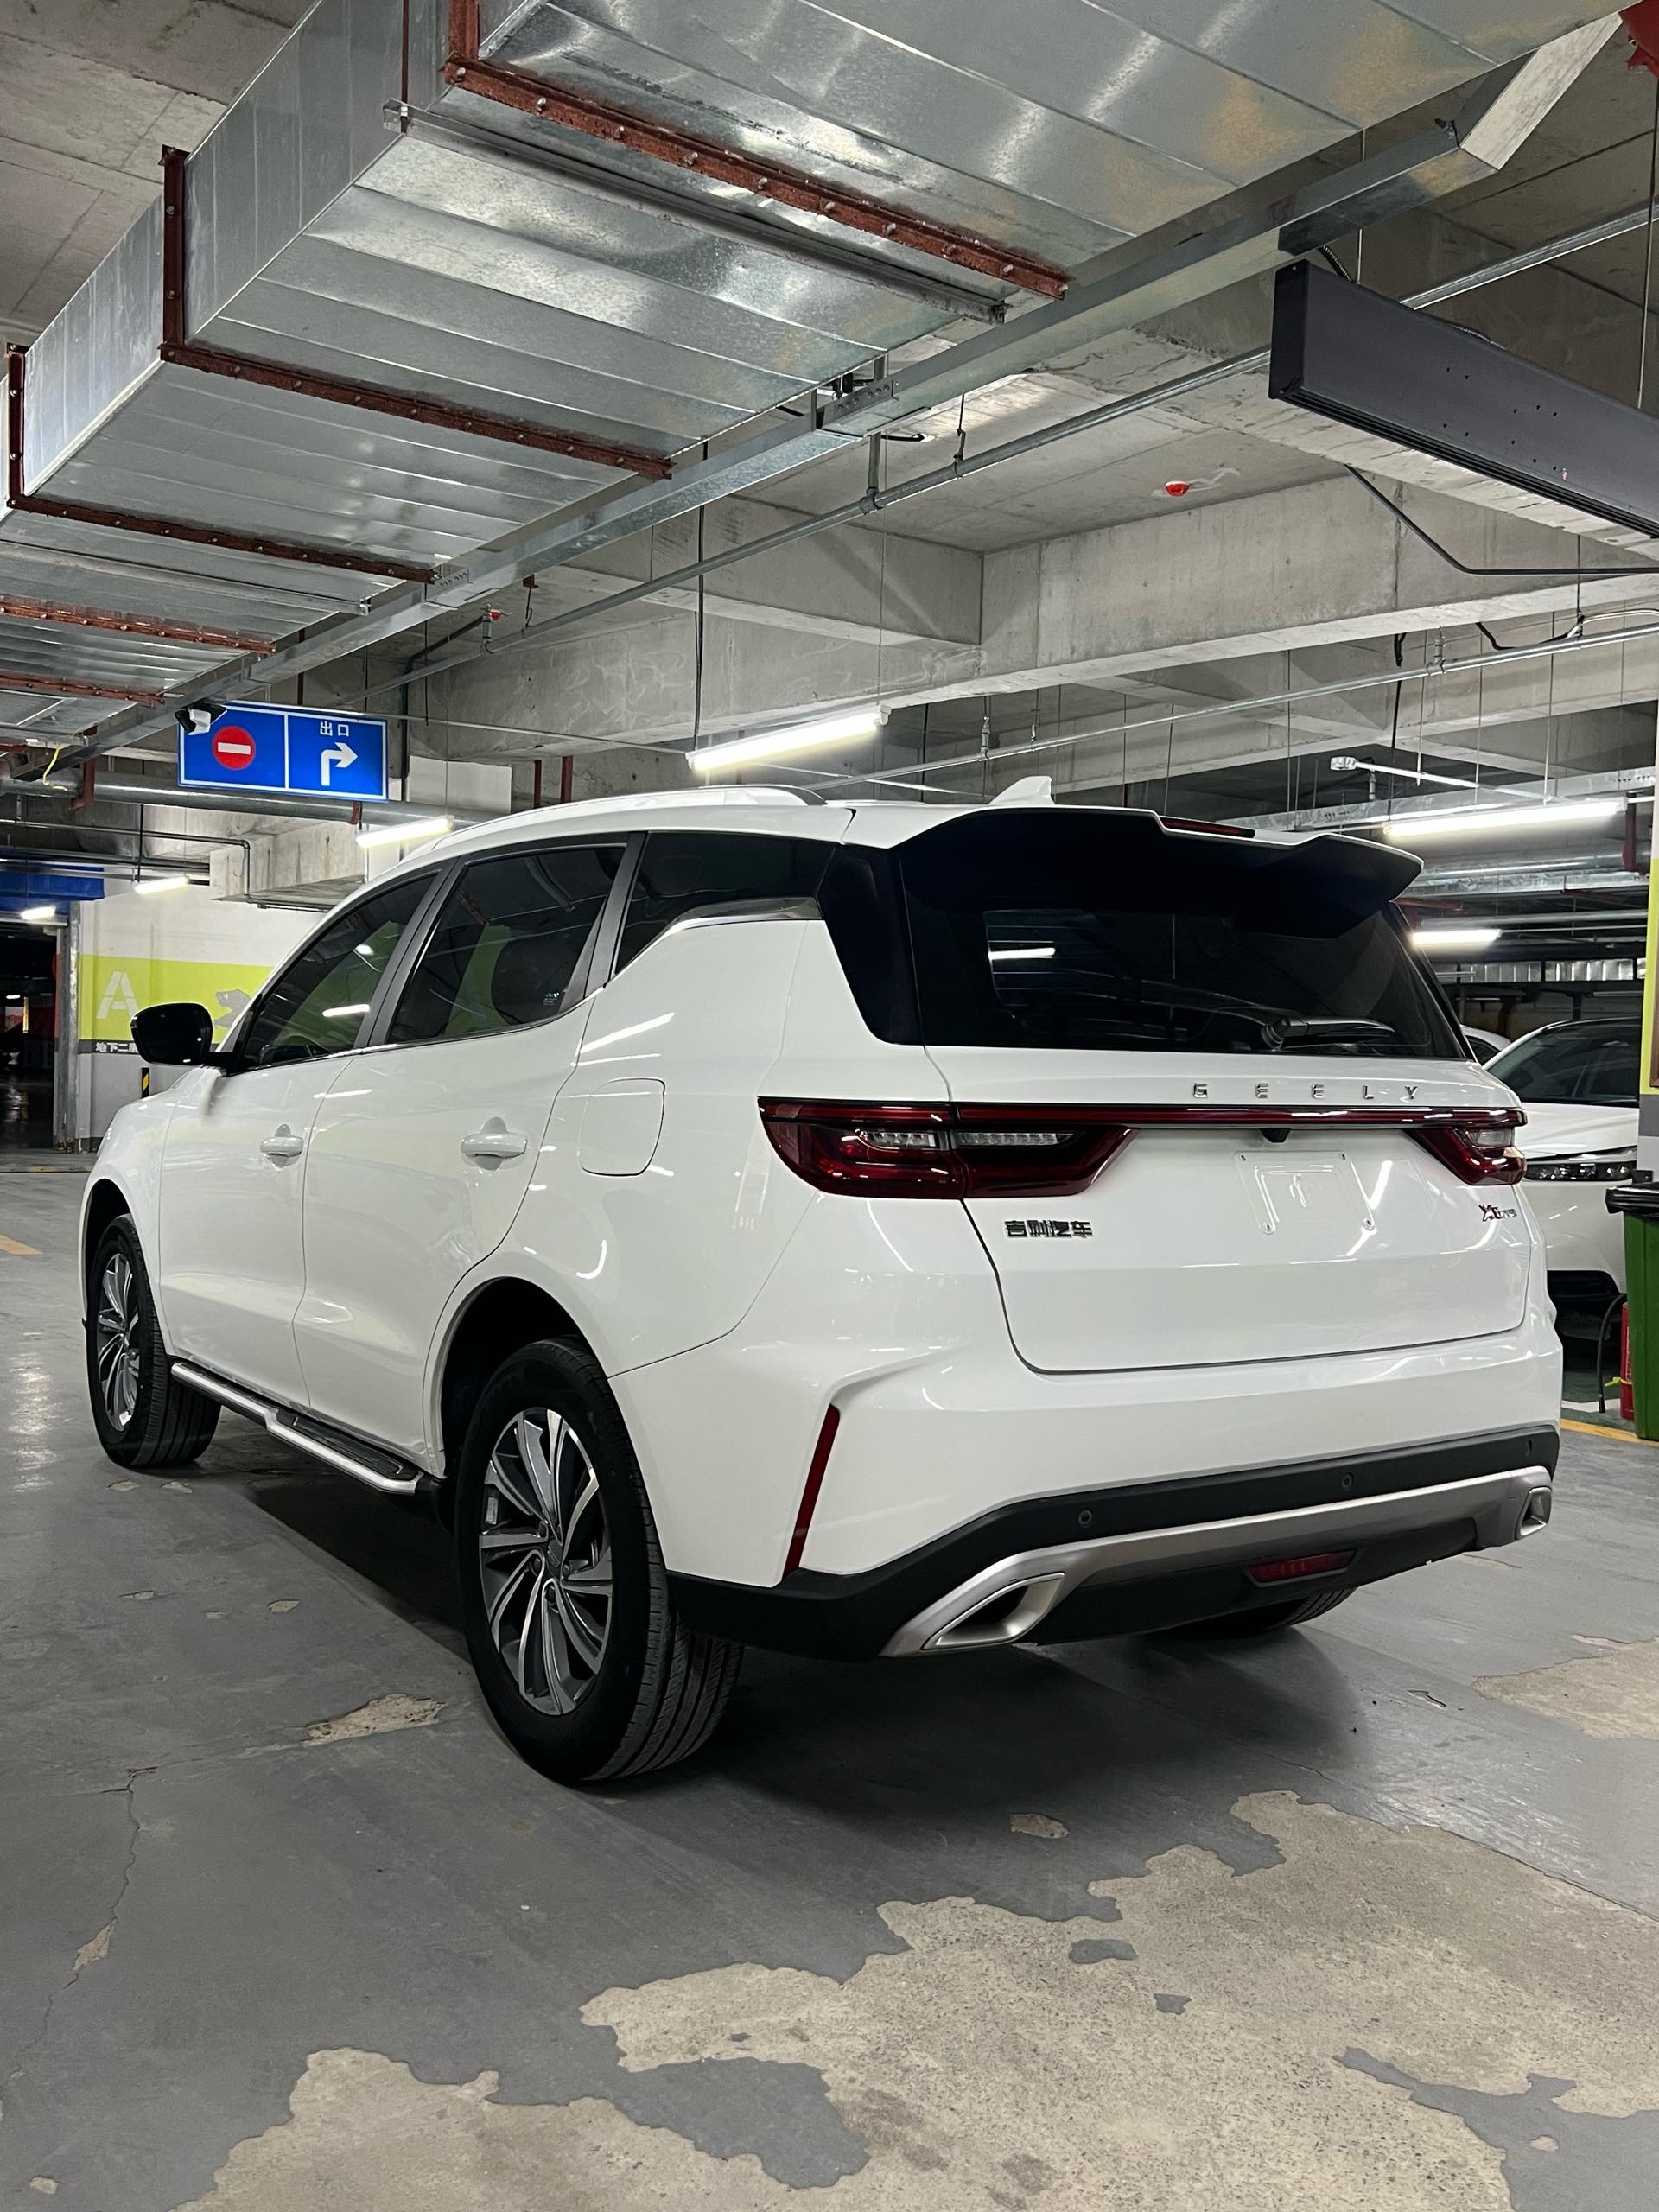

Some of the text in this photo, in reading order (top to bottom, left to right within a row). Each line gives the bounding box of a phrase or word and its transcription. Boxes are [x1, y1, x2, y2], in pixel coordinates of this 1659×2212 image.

[320, 721, 349, 737] 出口
[96, 970, 139, 1020] A
[1192, 1082, 1418, 1100] GEELY
[1004, 1219, 1093, 1238] 吉利汽车
